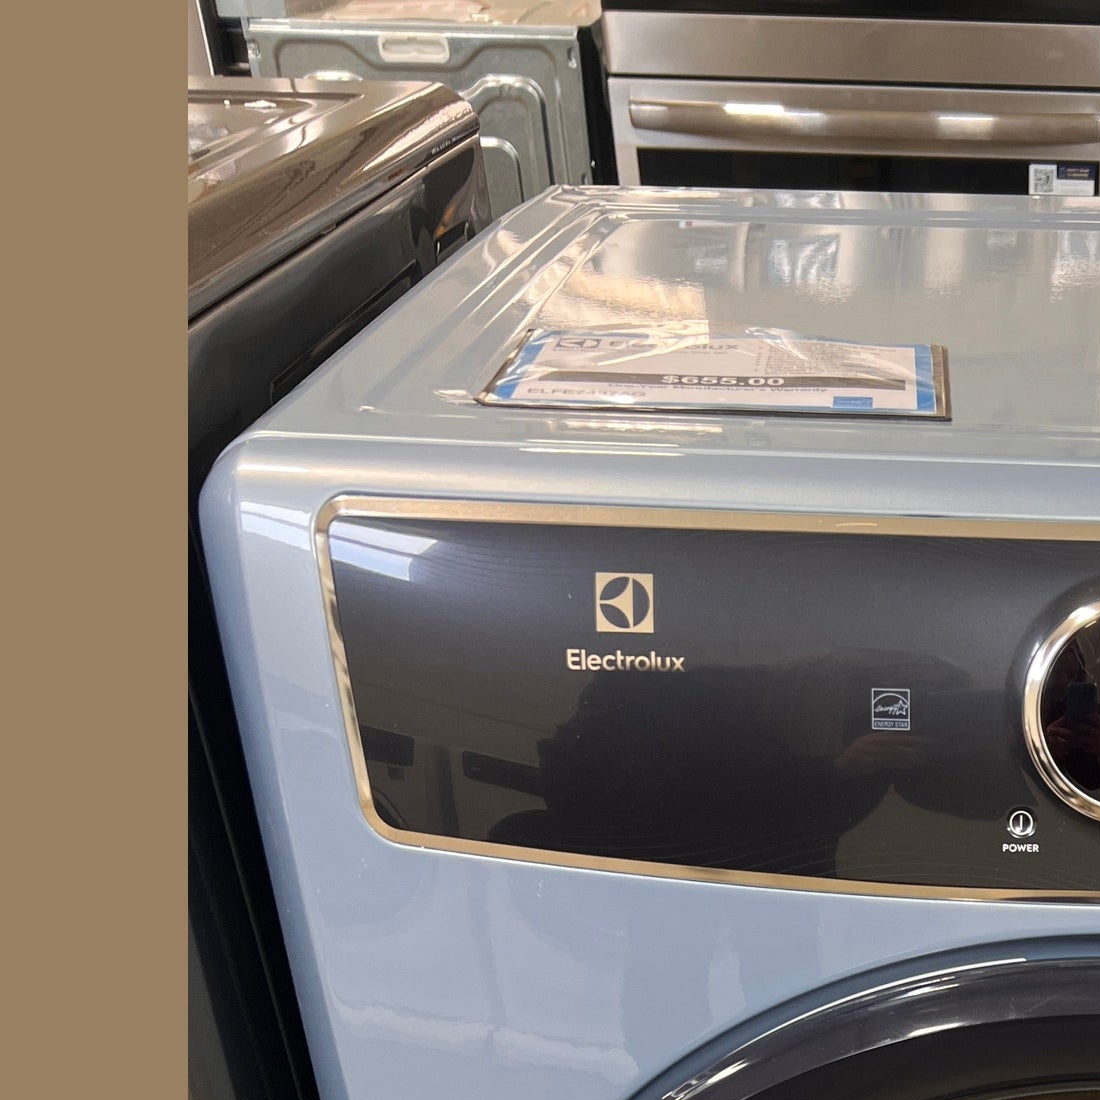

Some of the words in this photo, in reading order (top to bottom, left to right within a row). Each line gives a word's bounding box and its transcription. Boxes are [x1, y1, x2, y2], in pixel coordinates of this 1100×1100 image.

[661, 375, 785, 386] $655.00
[566, 648, 686, 673] Electrolux
[1002, 843, 1040, 853] POWER
